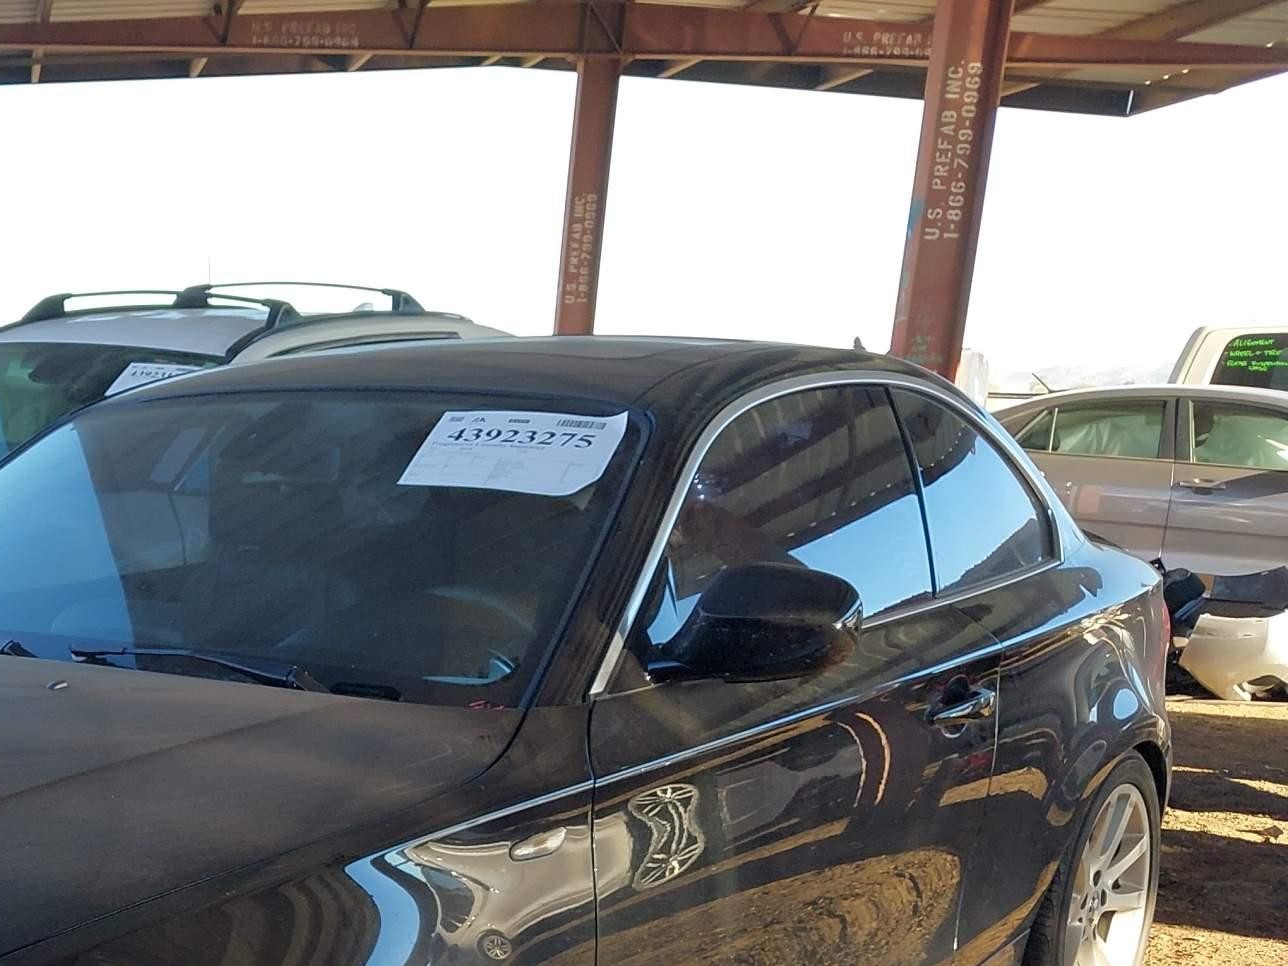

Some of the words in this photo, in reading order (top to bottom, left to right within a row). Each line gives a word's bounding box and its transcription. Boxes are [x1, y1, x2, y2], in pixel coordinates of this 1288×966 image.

[945, 60, 965, 99] INC.
[932, 110, 957, 190] PREFAB
[944, 62, 983, 239] 1-866-799-0969
[924, 202, 944, 240] U.S.
[447, 427, 597, 449] 43923275
